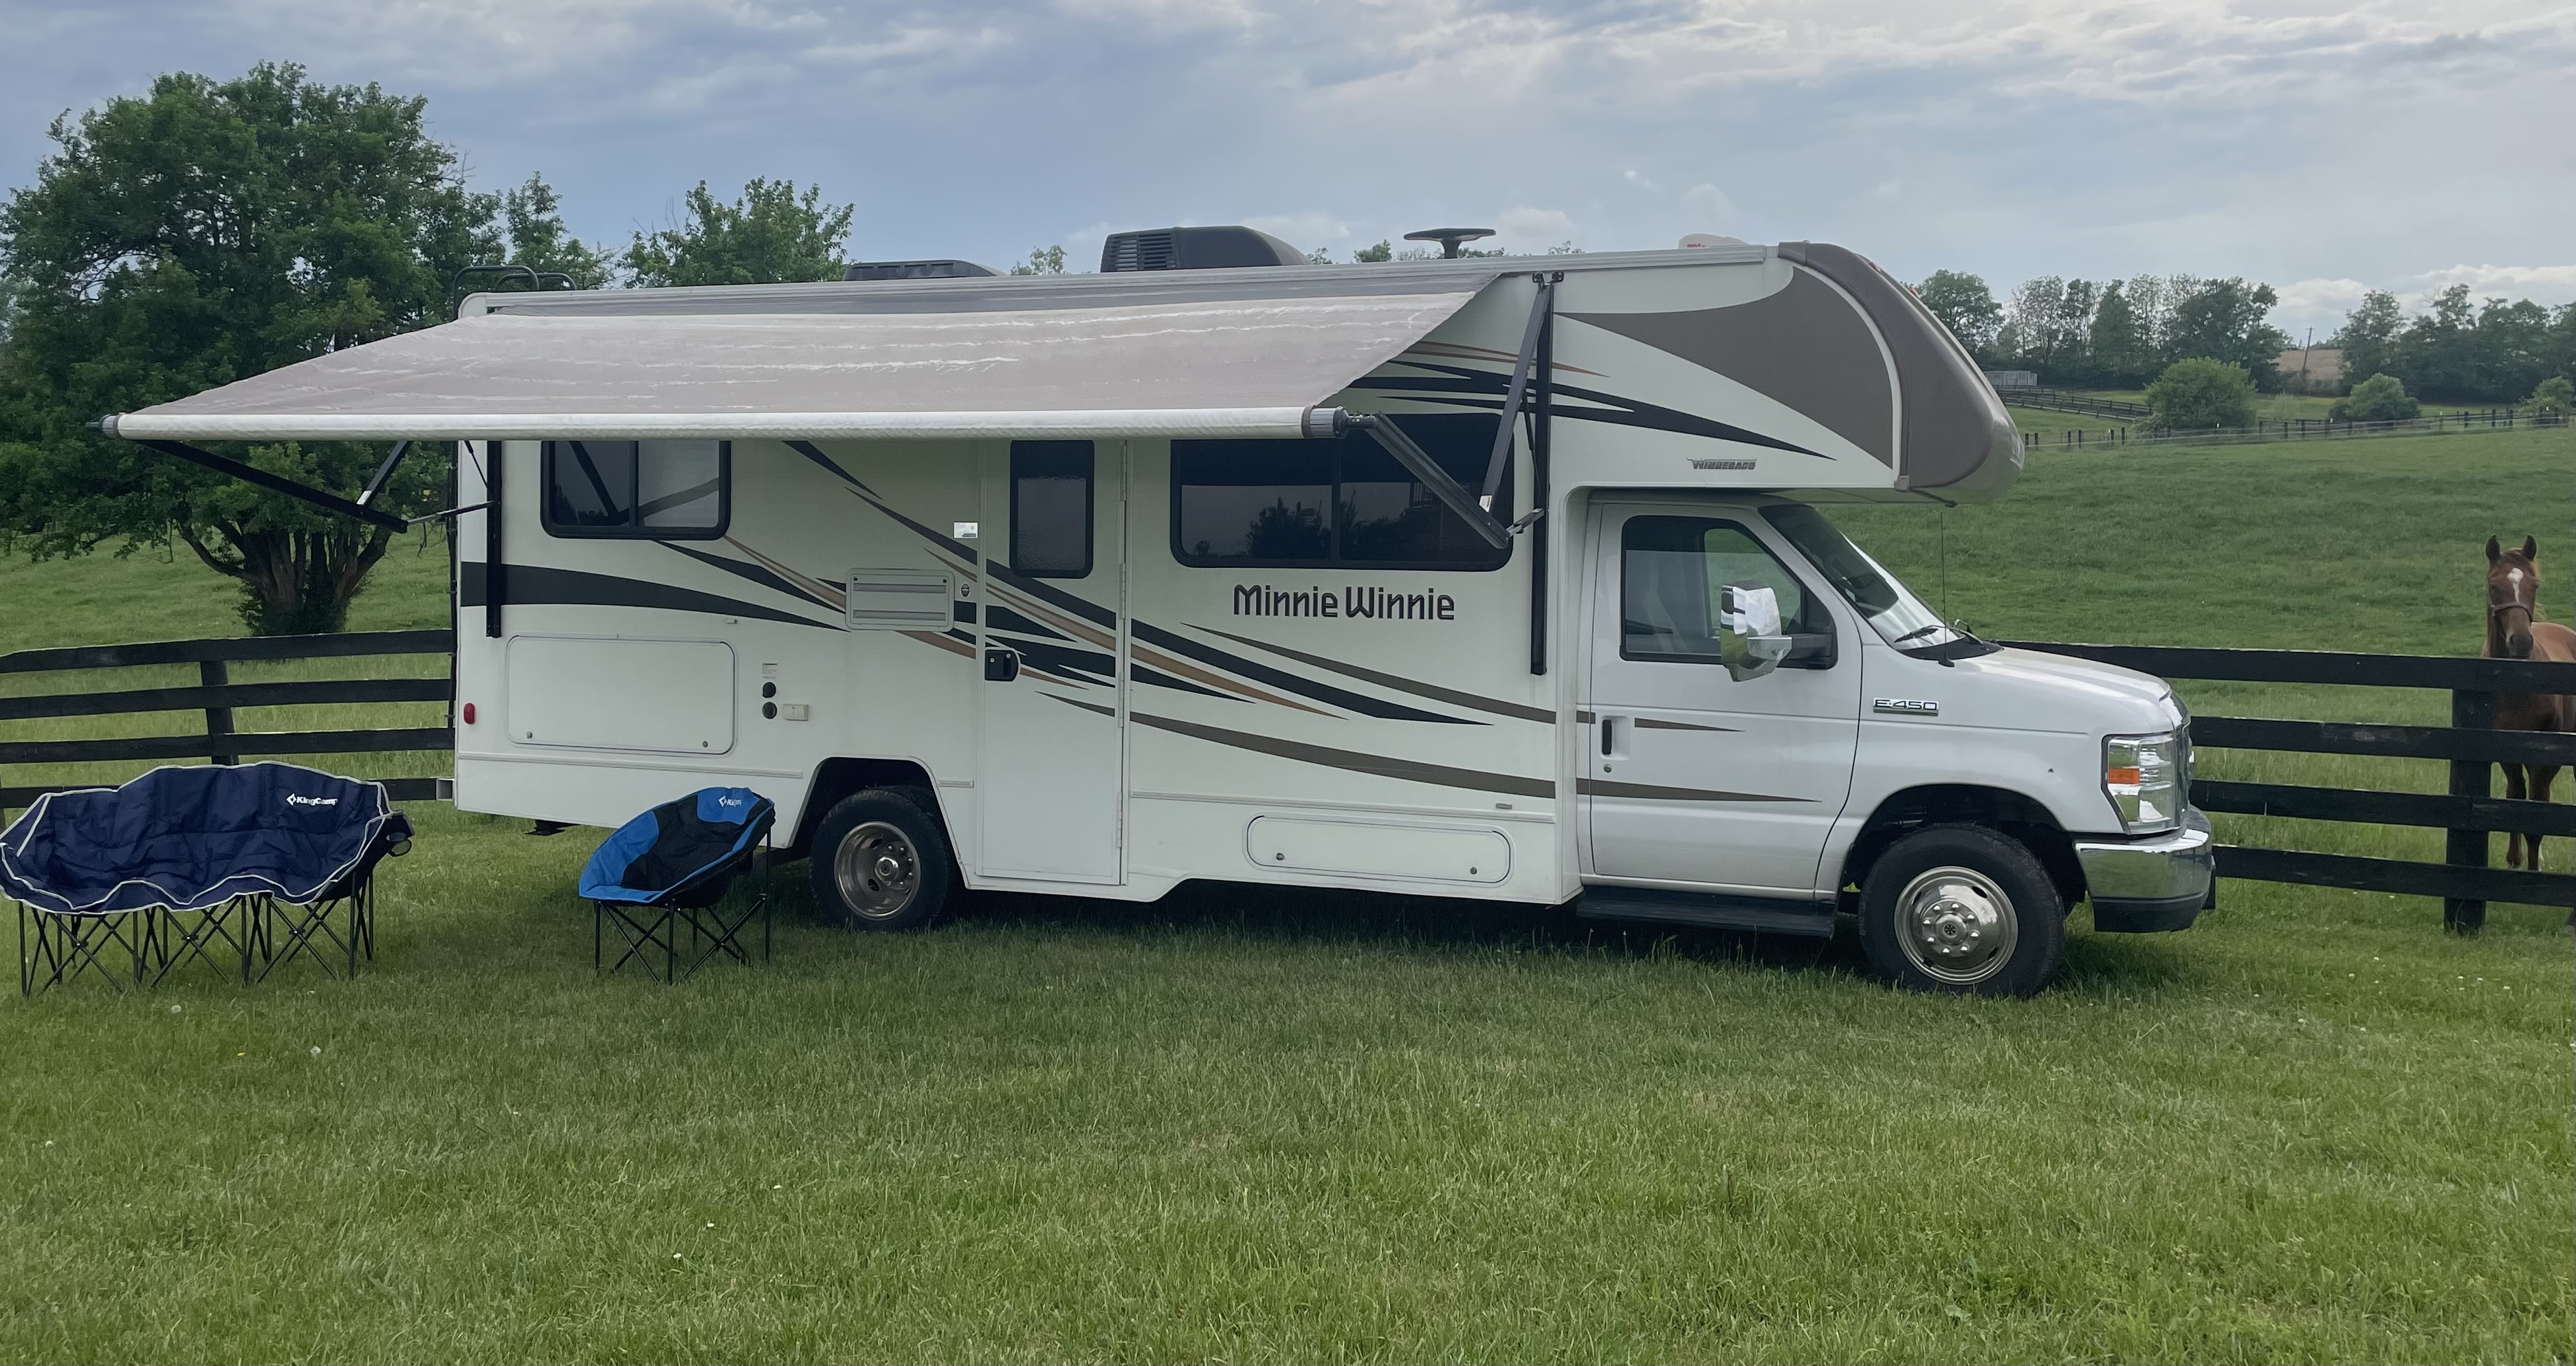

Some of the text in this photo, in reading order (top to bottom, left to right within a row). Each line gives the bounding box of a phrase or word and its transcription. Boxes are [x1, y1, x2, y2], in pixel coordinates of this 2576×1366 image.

[1233, 584, 1455, 621] Minnie Winnie
[296, 796, 338, 806] KingCamp
